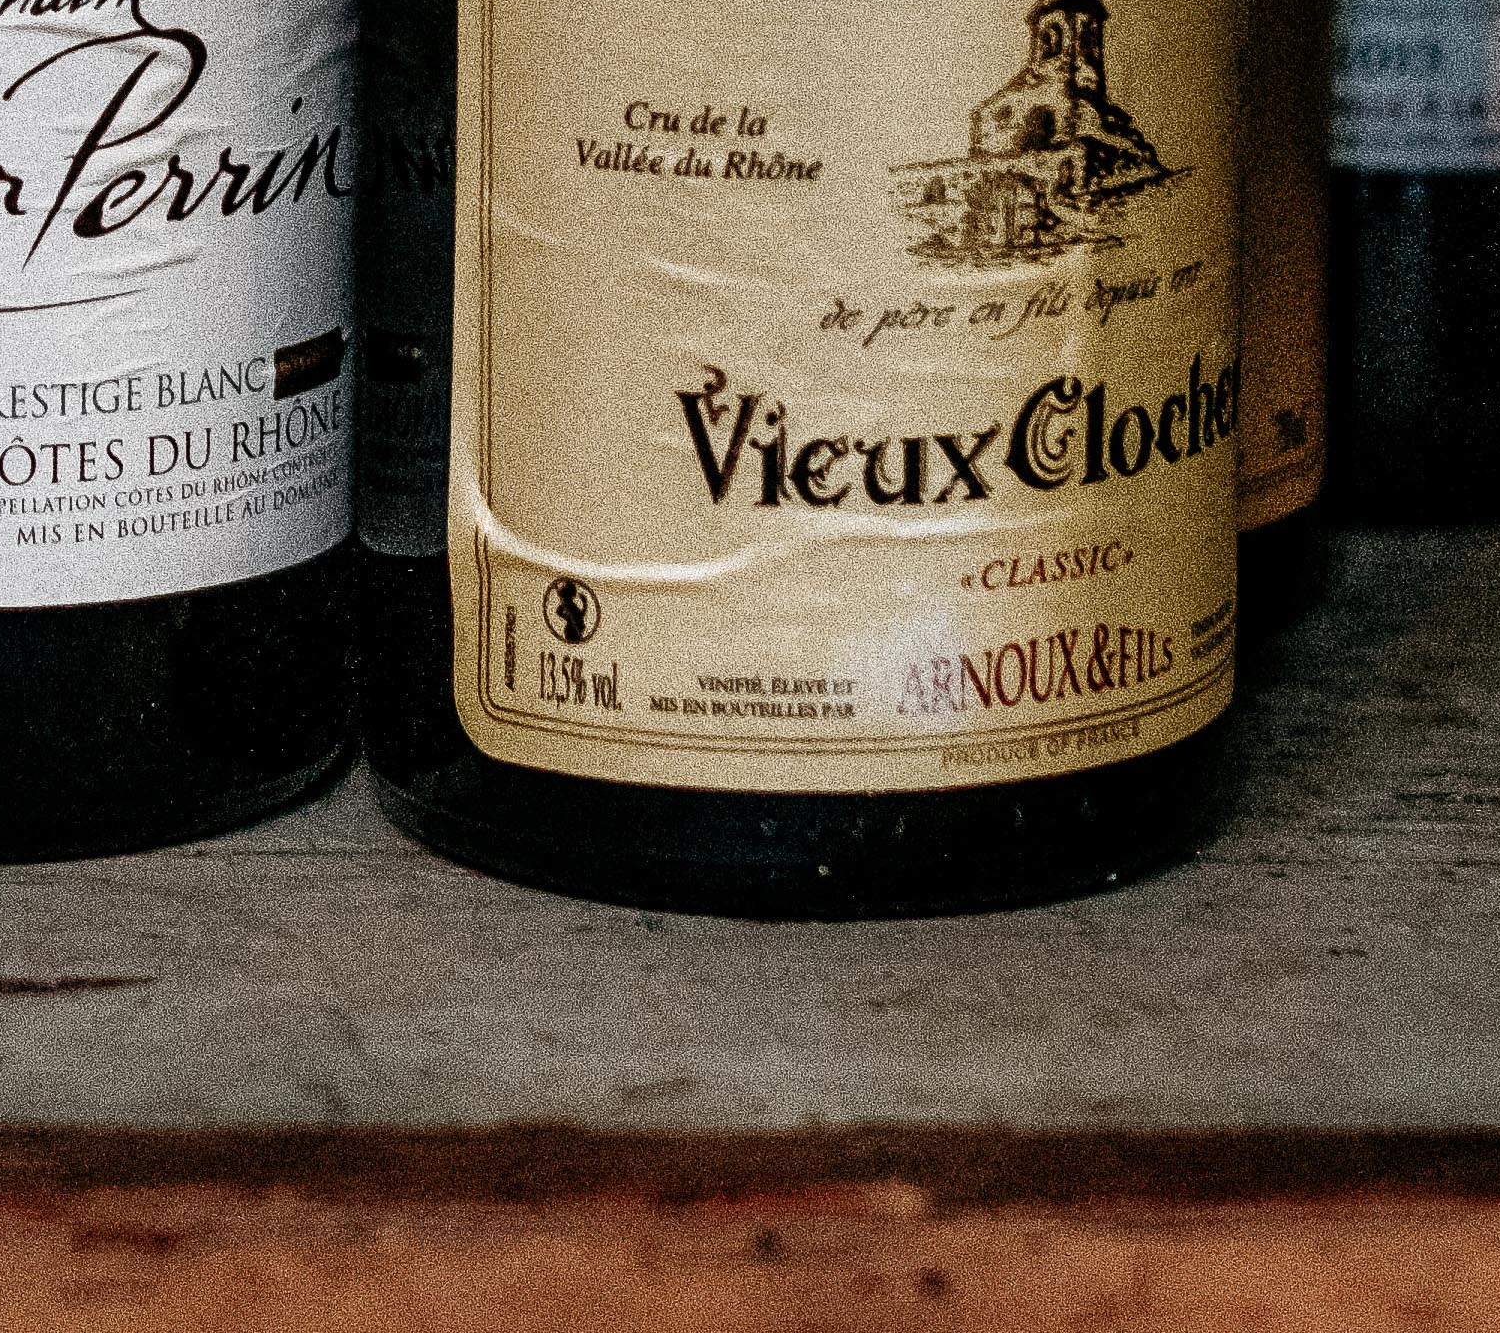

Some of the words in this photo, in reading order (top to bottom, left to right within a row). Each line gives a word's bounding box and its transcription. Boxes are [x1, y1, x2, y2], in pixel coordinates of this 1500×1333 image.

[622, 99, 683, 136] Cru
[690, 104, 731, 136] de
[736, 108, 768, 136] la
[2, 26, 354, 272] Perrin
[574, 139, 663, 177] Vallée
[672, 146, 714, 179] du
[722, 146, 823, 183] Rhône
[818, 296, 866, 333] de
[155, 354, 269, 411] BLANC
[146, 426, 214, 479] DU
[229, 388, 342, 465] RHÔNE
[674, 363, 1002, 510] Vieux
[14, 524, 64, 549] MIS
[72, 520, 107, 544] EN
[115, 501, 237, 542] BOUTEILLE
[240, 492, 268, 520] AU
[113, 482, 175, 512] CÔTES
[179, 478, 208, 502] DU
[590, 659, 625, 713] vol.
[648, 694, 680, 715] MIS
[681, 696, 709, 717] EN
[821, 700, 858, 721] PAR
